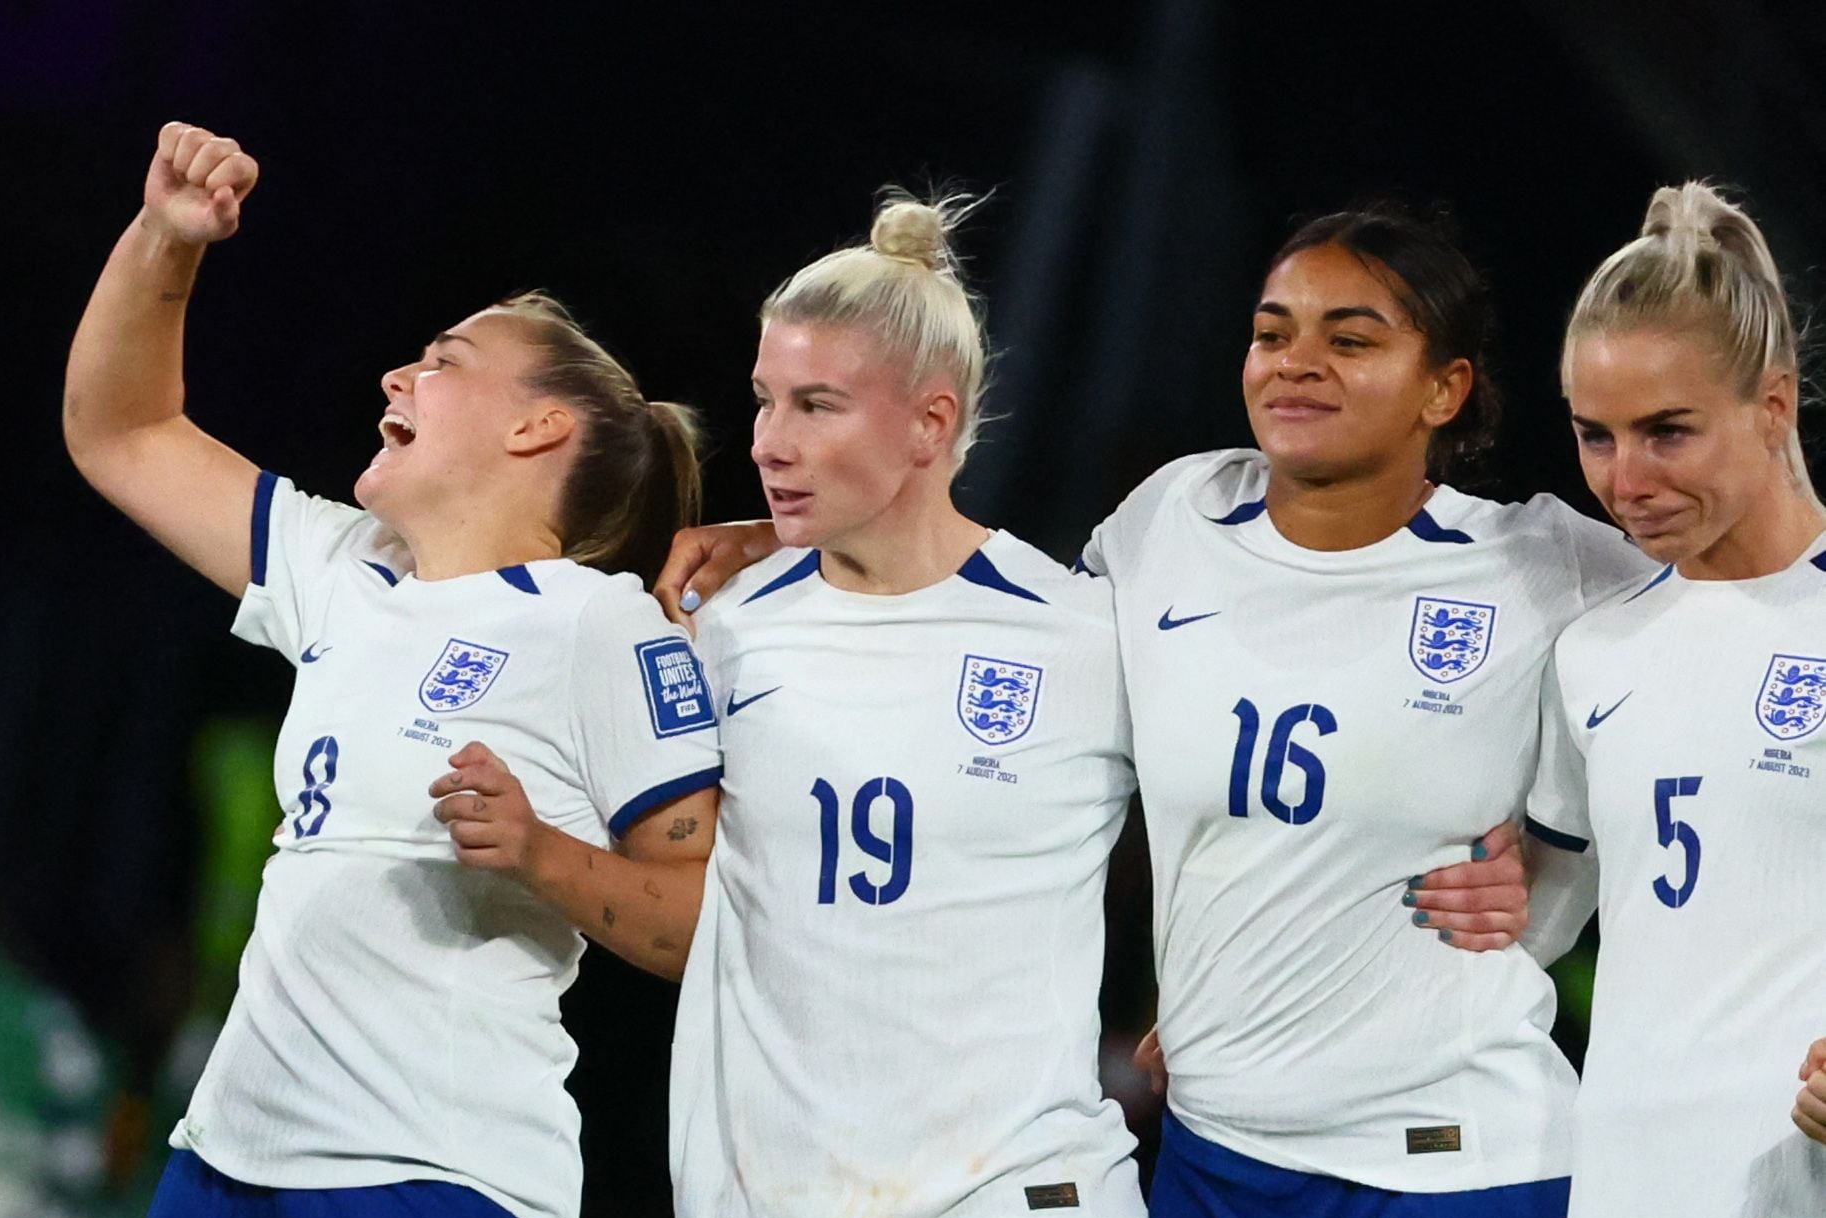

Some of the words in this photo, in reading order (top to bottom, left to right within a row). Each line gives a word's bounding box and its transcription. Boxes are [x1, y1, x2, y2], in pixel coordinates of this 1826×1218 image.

[655, 651, 692, 669] FOOTBALL
[659, 663, 696, 687] UNITES
[661, 686, 679, 703] the
[678, 680, 702, 699] World
[680, 703, 696, 713] FIFA
[396, 726, 404, 736] 7
[431, 735, 453, 748] 2023
[1229, 698, 1337, 824] 16
[1749, 758, 1756, 769] 7
[1788, 764, 1810, 778] 2023
[957, 764, 964, 774] 7
[997, 771, 1018, 784] 2023
[293, 735, 339, 838] 8
[811, 777, 914, 905] 19
[1653, 777, 1703, 908] 5
